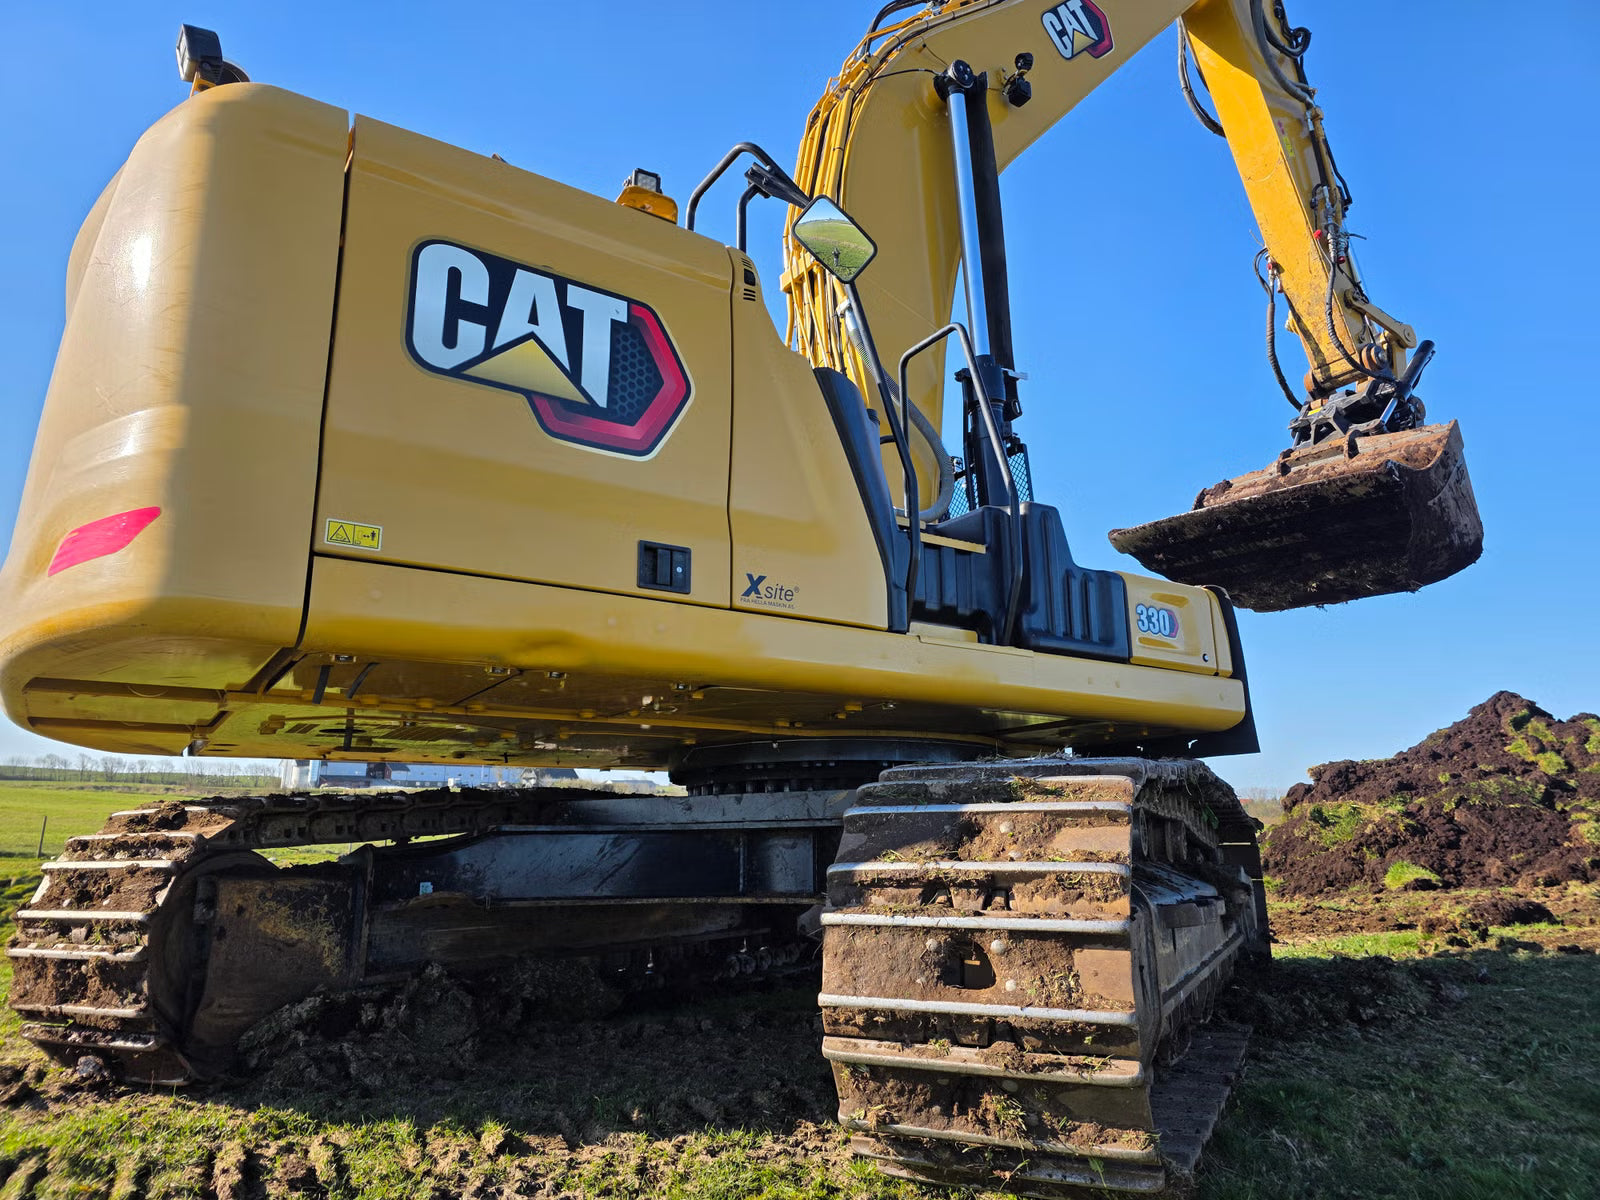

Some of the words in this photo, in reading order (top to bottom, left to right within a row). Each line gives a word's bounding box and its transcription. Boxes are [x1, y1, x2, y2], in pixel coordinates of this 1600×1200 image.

[1042, 0, 1099, 58] CAT
[412, 243, 628, 408] CAT
[1136, 604, 1170, 636] 330
